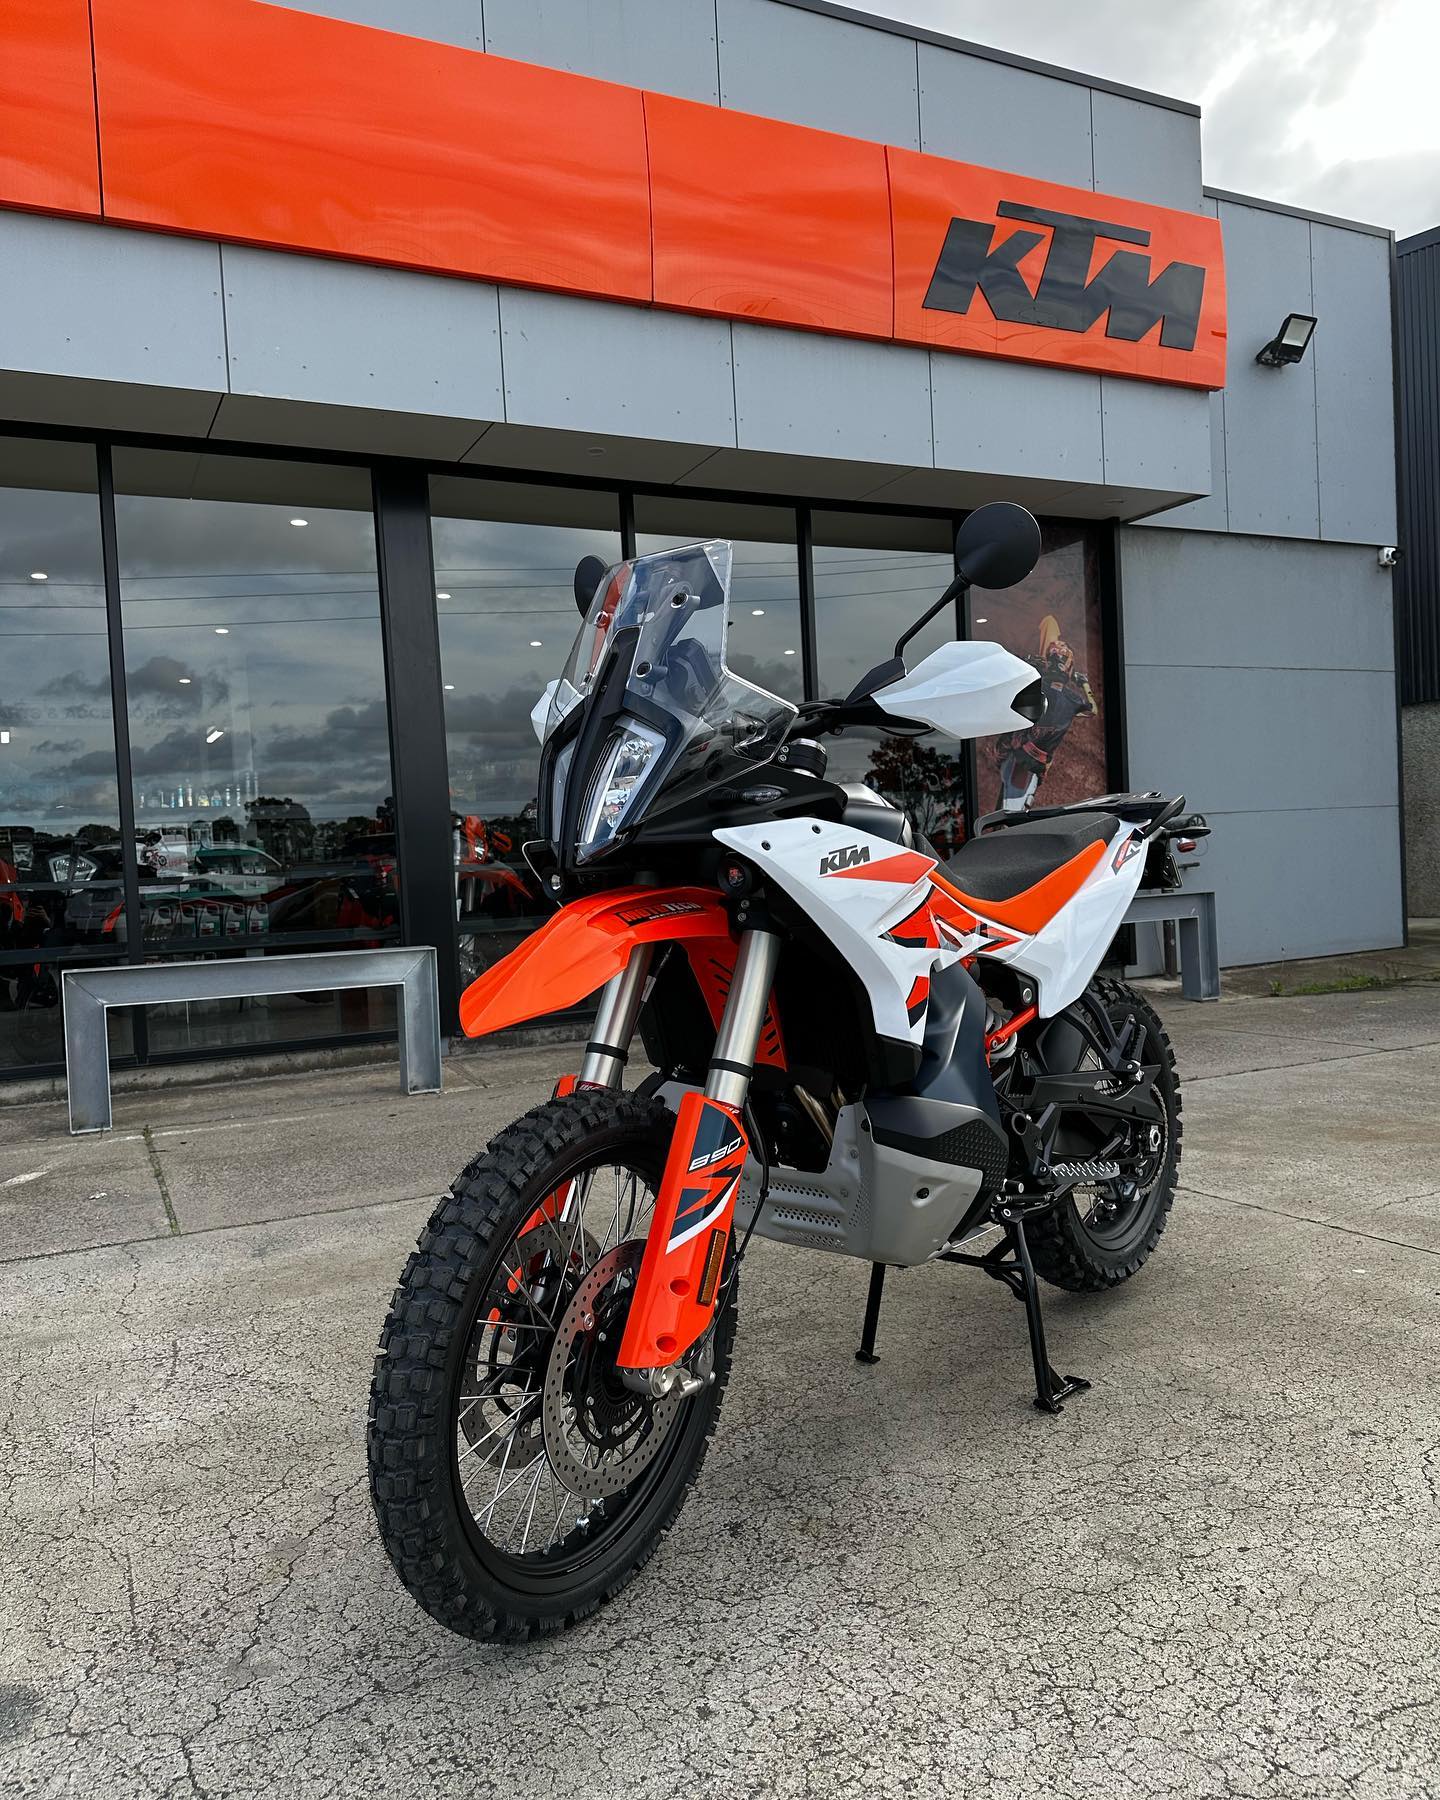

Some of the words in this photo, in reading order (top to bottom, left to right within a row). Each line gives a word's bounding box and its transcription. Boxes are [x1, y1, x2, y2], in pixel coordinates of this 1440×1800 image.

[922, 200, 1206, 351] KTM
[820, 845, 870, 875] KTM
[619, 902, 702, 922] MOTOTECH
[689, 1136, 742, 1171] 890
